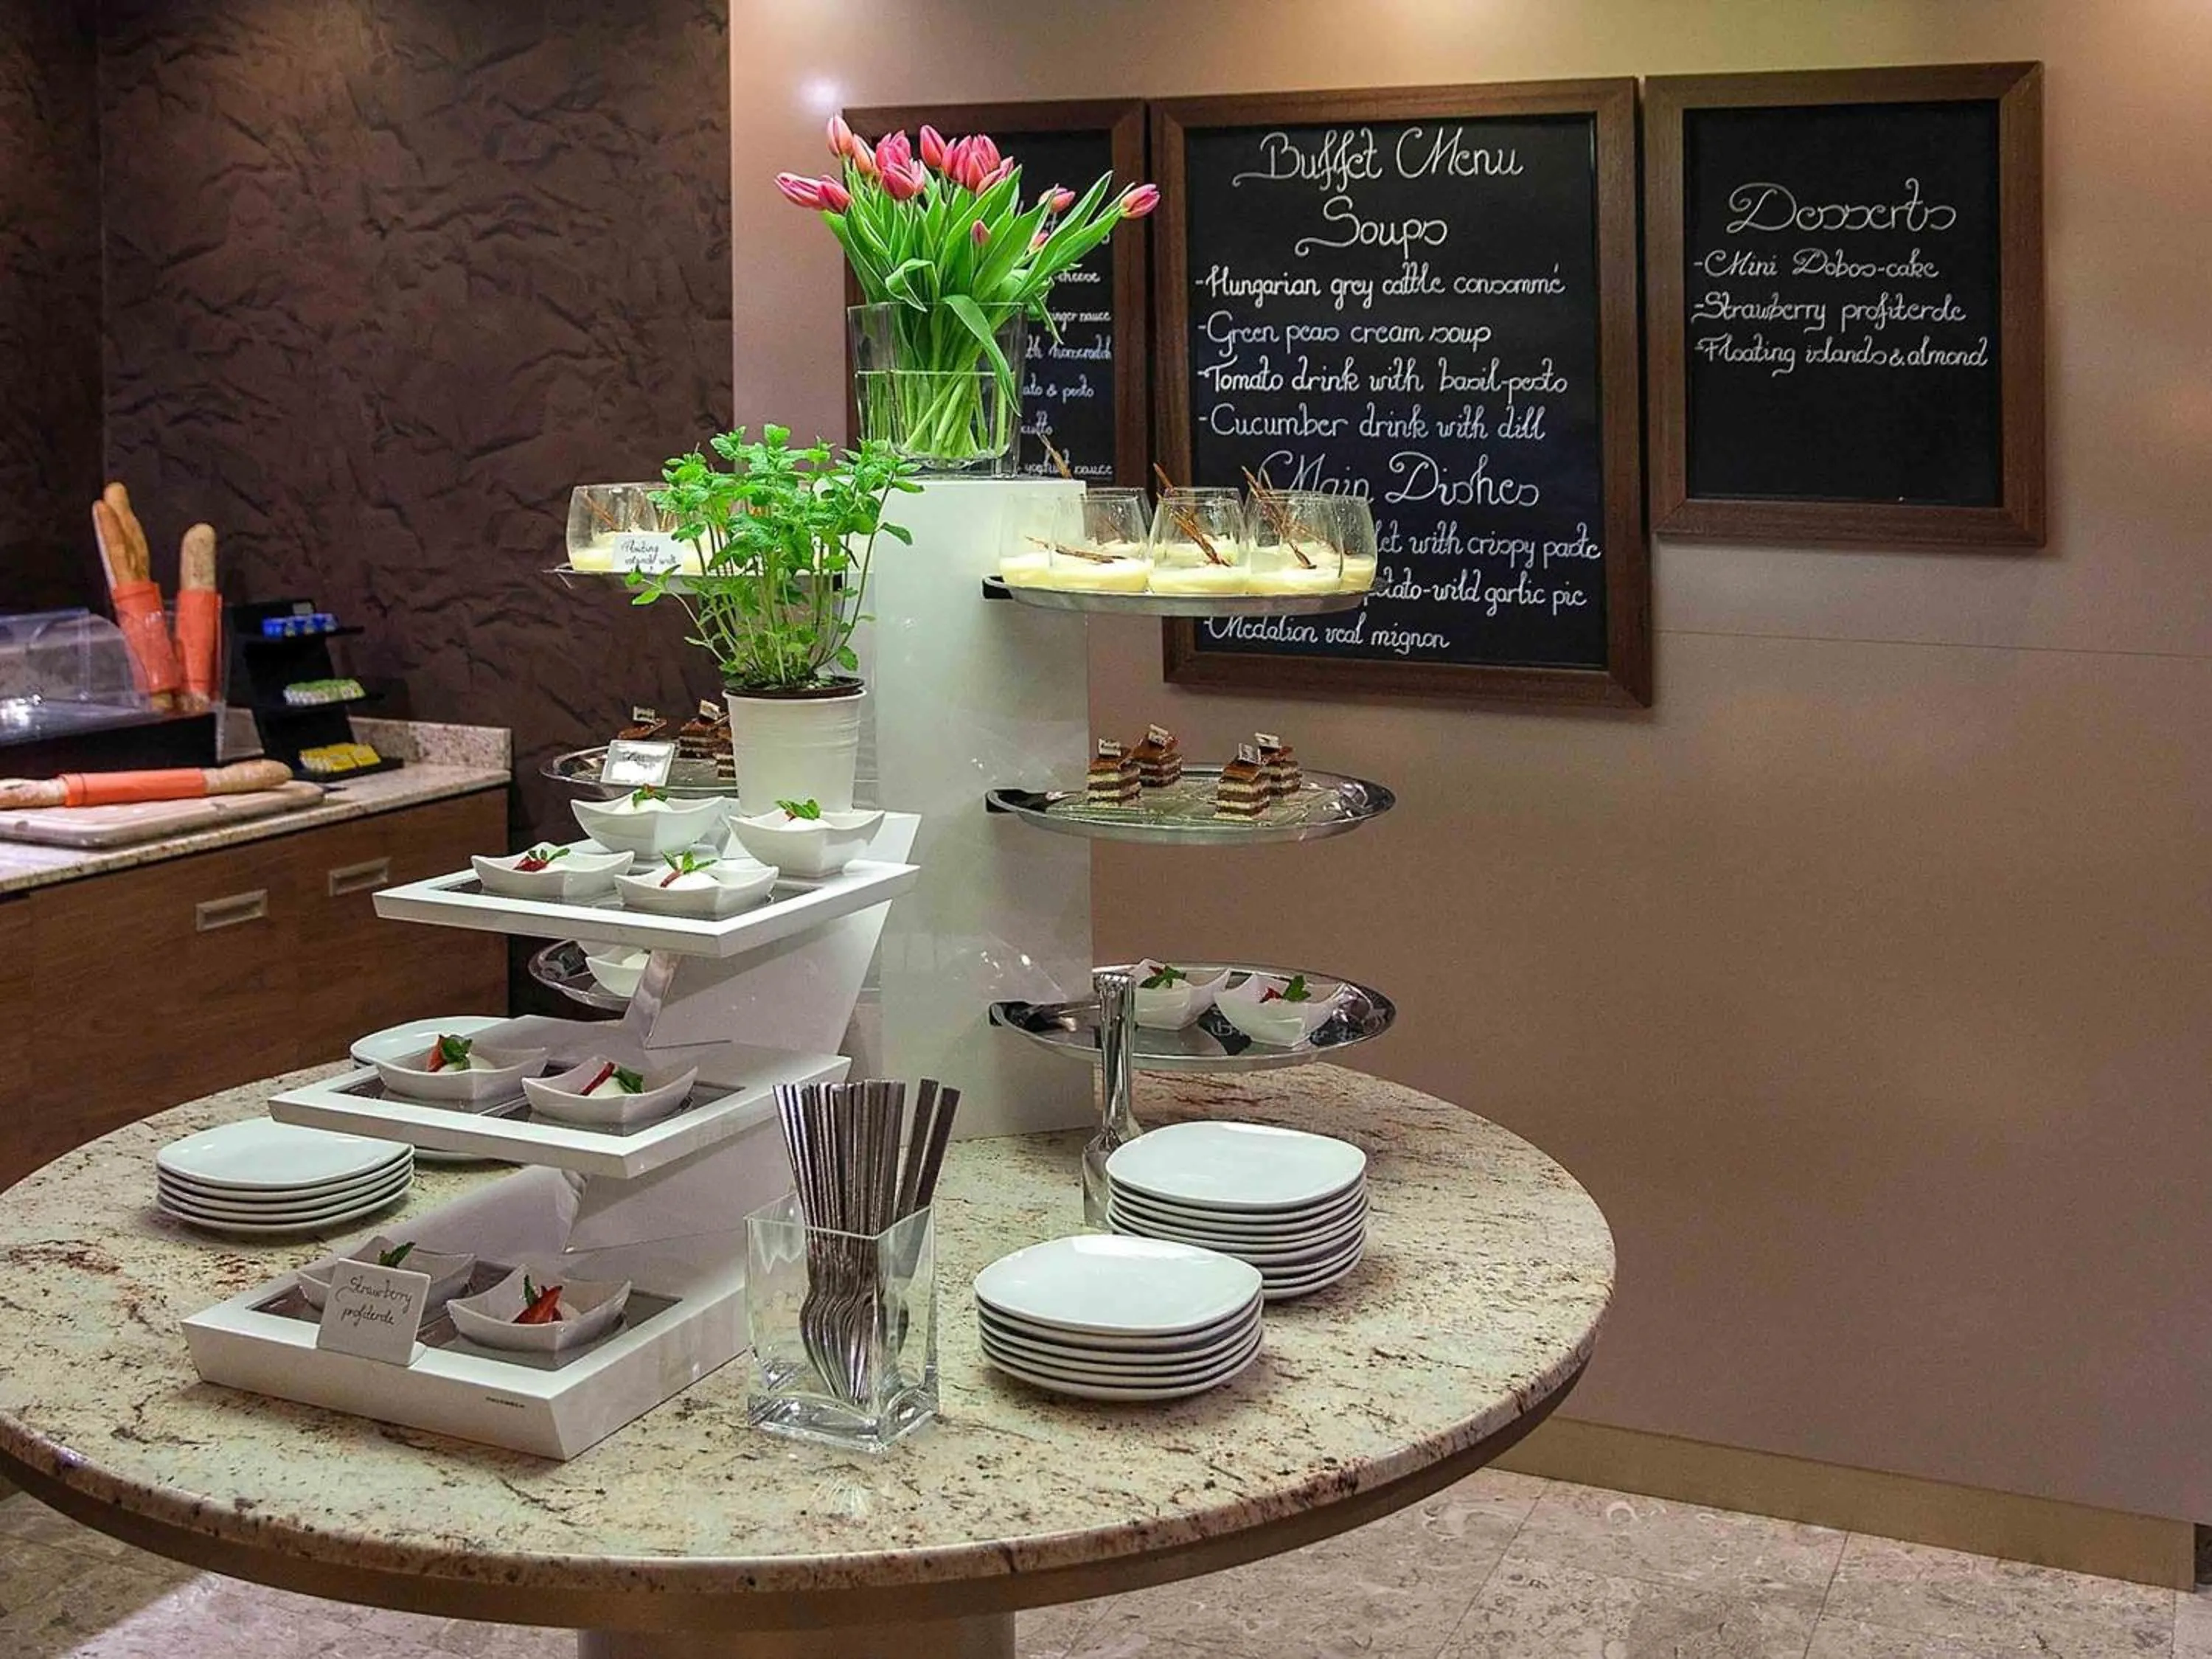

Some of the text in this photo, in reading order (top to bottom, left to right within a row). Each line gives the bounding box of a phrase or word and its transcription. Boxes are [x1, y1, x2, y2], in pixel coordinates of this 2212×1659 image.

[1232, 127, 1524, 192] Buffet Menu
[1295, 195, 1448, 259] Soups
[1726, 178, 1956, 233] Desserts
[1330, 276, 1373, 311] grey
[1382, 262, 1446, 295] cattle
[1454, 263, 1566, 294] consommé
[1286, 324, 1340, 354] peas
[1351, 324, 1427, 343] cream
[1429, 324, 1492, 352] soup
[1291, 355, 1360, 392] drink
[1369, 357, 1424, 392] with
[1359, 402, 1429, 439] drink
[1436, 405, 1489, 439] with
[1498, 404, 1547, 441] dill
[1385, 451, 1540, 507] Dishes
[1408, 520, 1464, 554] with
[1467, 530, 1535, 569] crispy
[1484, 570, 1546, 617] garlic
[1553, 581, 1587, 616] pie
[1325, 611, 1368, 644] veal
[1371, 622, 1450, 655] mignon
